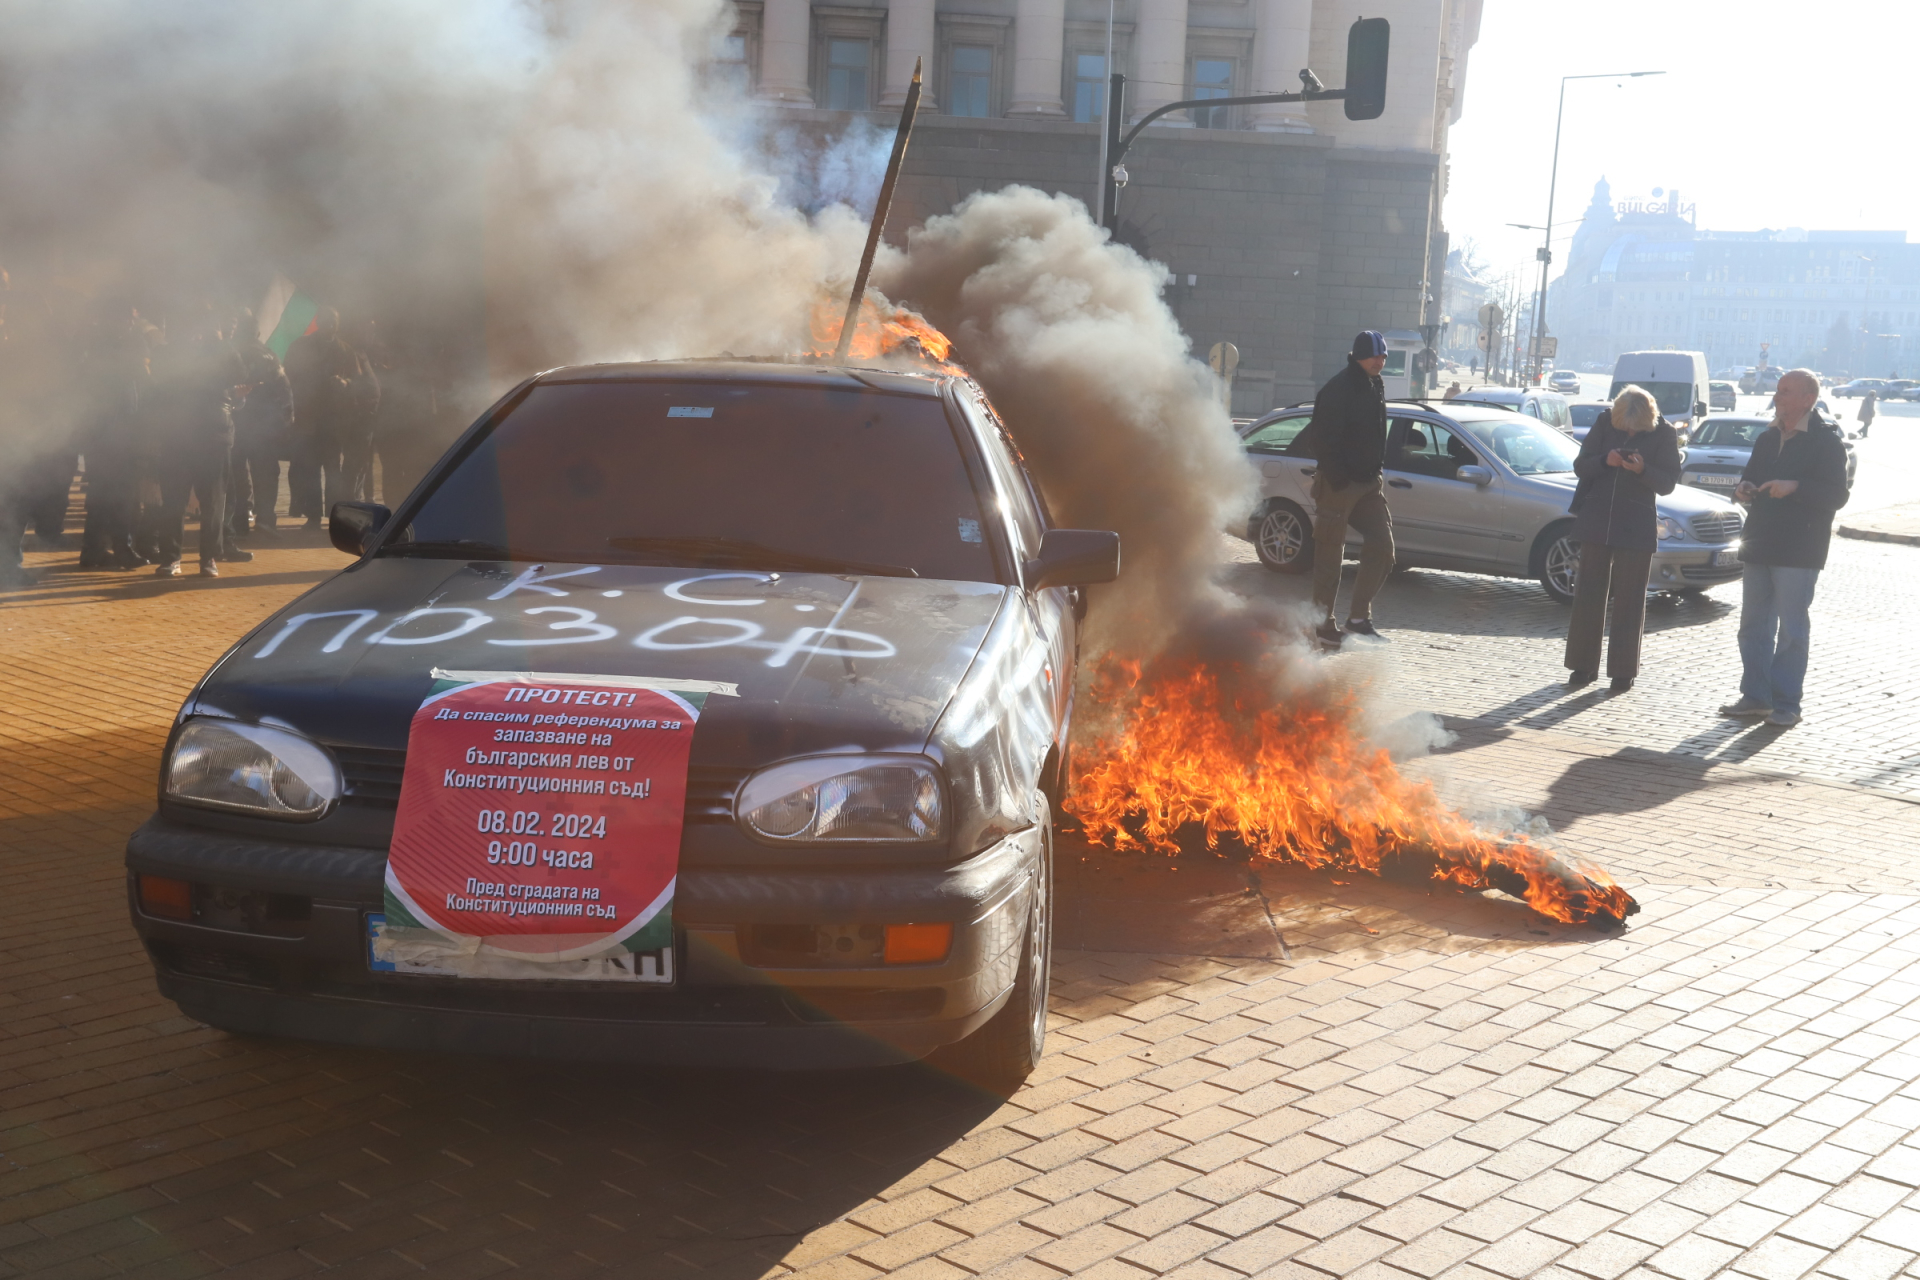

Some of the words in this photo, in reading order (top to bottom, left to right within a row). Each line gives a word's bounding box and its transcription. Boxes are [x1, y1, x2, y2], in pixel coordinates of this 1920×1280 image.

[1617, 202, 1696, 215] BULGARIA
[254, 606, 897, 668] ПОЗОР
[503, 687, 637, 707] ПРОТЕСТ!
[434, 708, 459, 721] Да
[463, 710, 531, 724] спасим
[532, 712, 656, 731] референдума
[660, 721, 682, 731] за
[493, 729, 587, 746] запазване
[590, 734, 612, 748] на
[465, 747, 572, 770] българския
[575, 755, 609, 770] лев
[613, 757, 634, 771] от
[443, 769, 605, 795] Конституционния
[609, 778, 650, 798] съд!
[477, 809, 545, 837] 08.02.
[551, 814, 607, 839] 2024
[487, 840, 537, 867] 9:00
[542, 850, 593, 869] часа
[466, 877, 505, 898] Пред
[508, 884, 579, 901] сградата
[581, 888, 601, 901] на
[446, 893, 582, 917] Конституционния
[586, 901, 616, 919] съд
